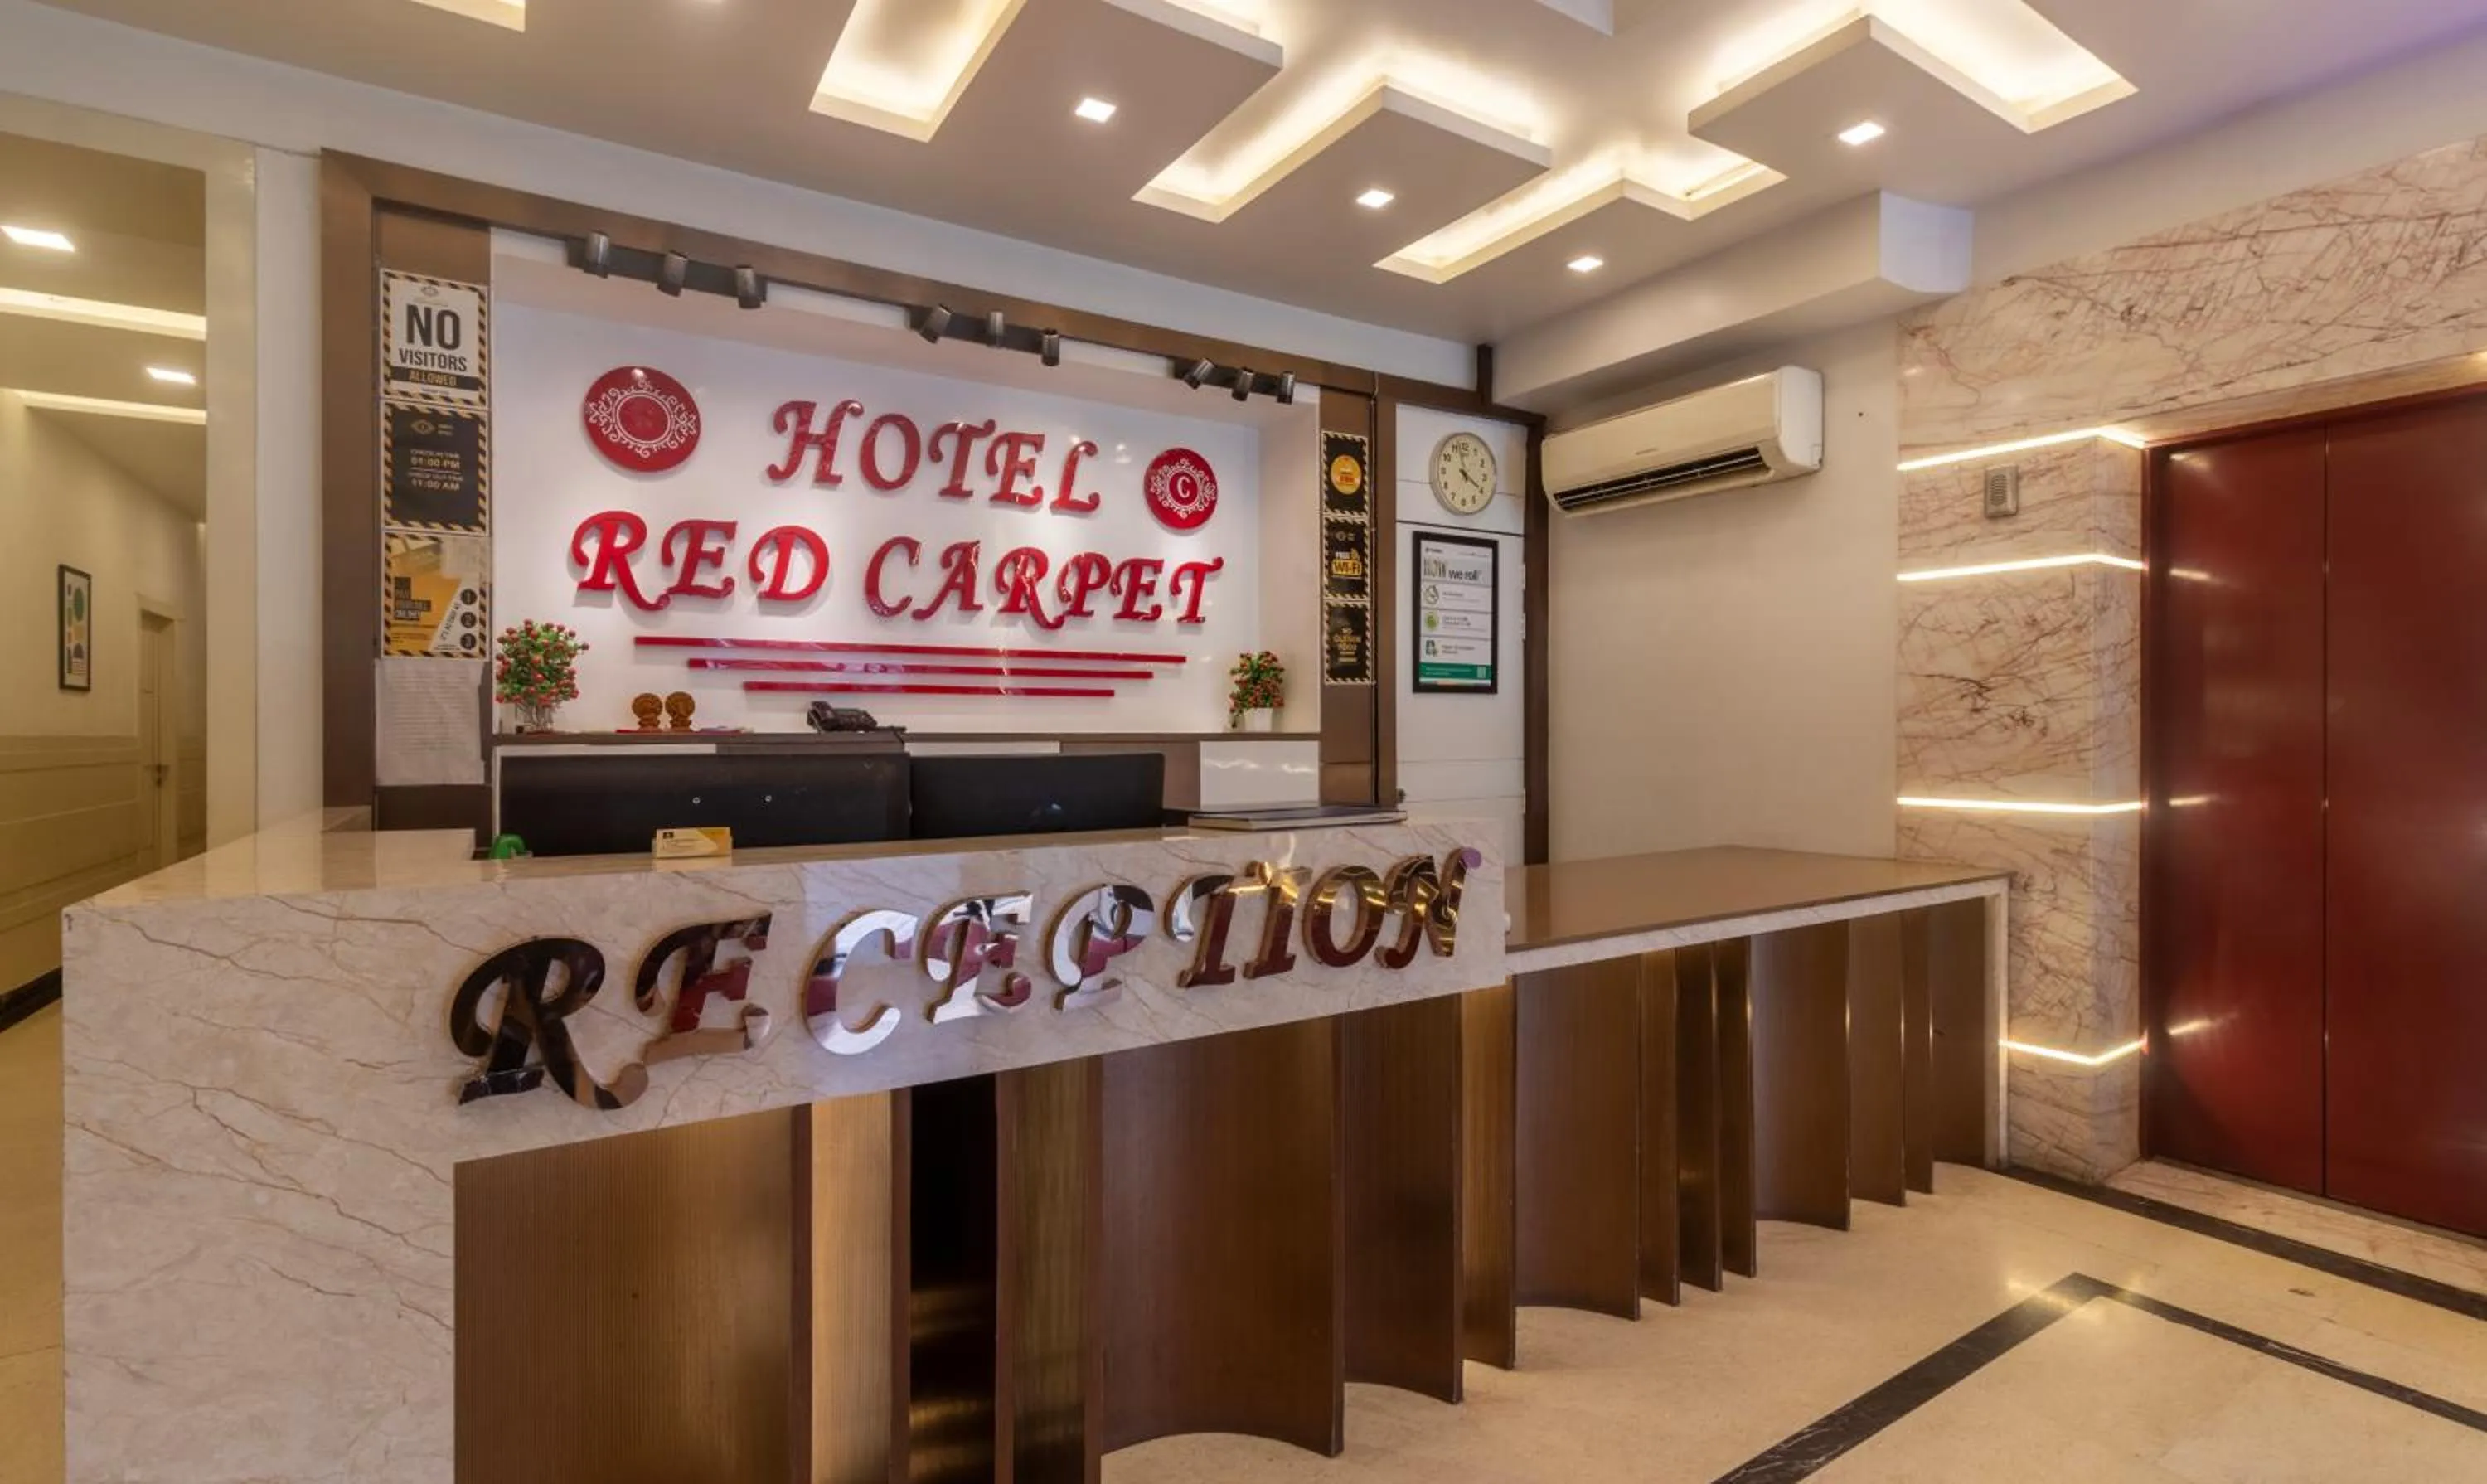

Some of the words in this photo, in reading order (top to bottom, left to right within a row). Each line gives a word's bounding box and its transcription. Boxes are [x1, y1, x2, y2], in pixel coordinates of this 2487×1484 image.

[398, 348, 468, 371] VISITORS
[406, 303, 461, 351] NO
[767, 400, 1100, 512] HOTEL
[1177, 476, 1190, 498] C
[570, 510, 829, 612] RED
[865, 536, 1224, 630] CARPET
[450, 846, 1482, 1110] RECEPTION
